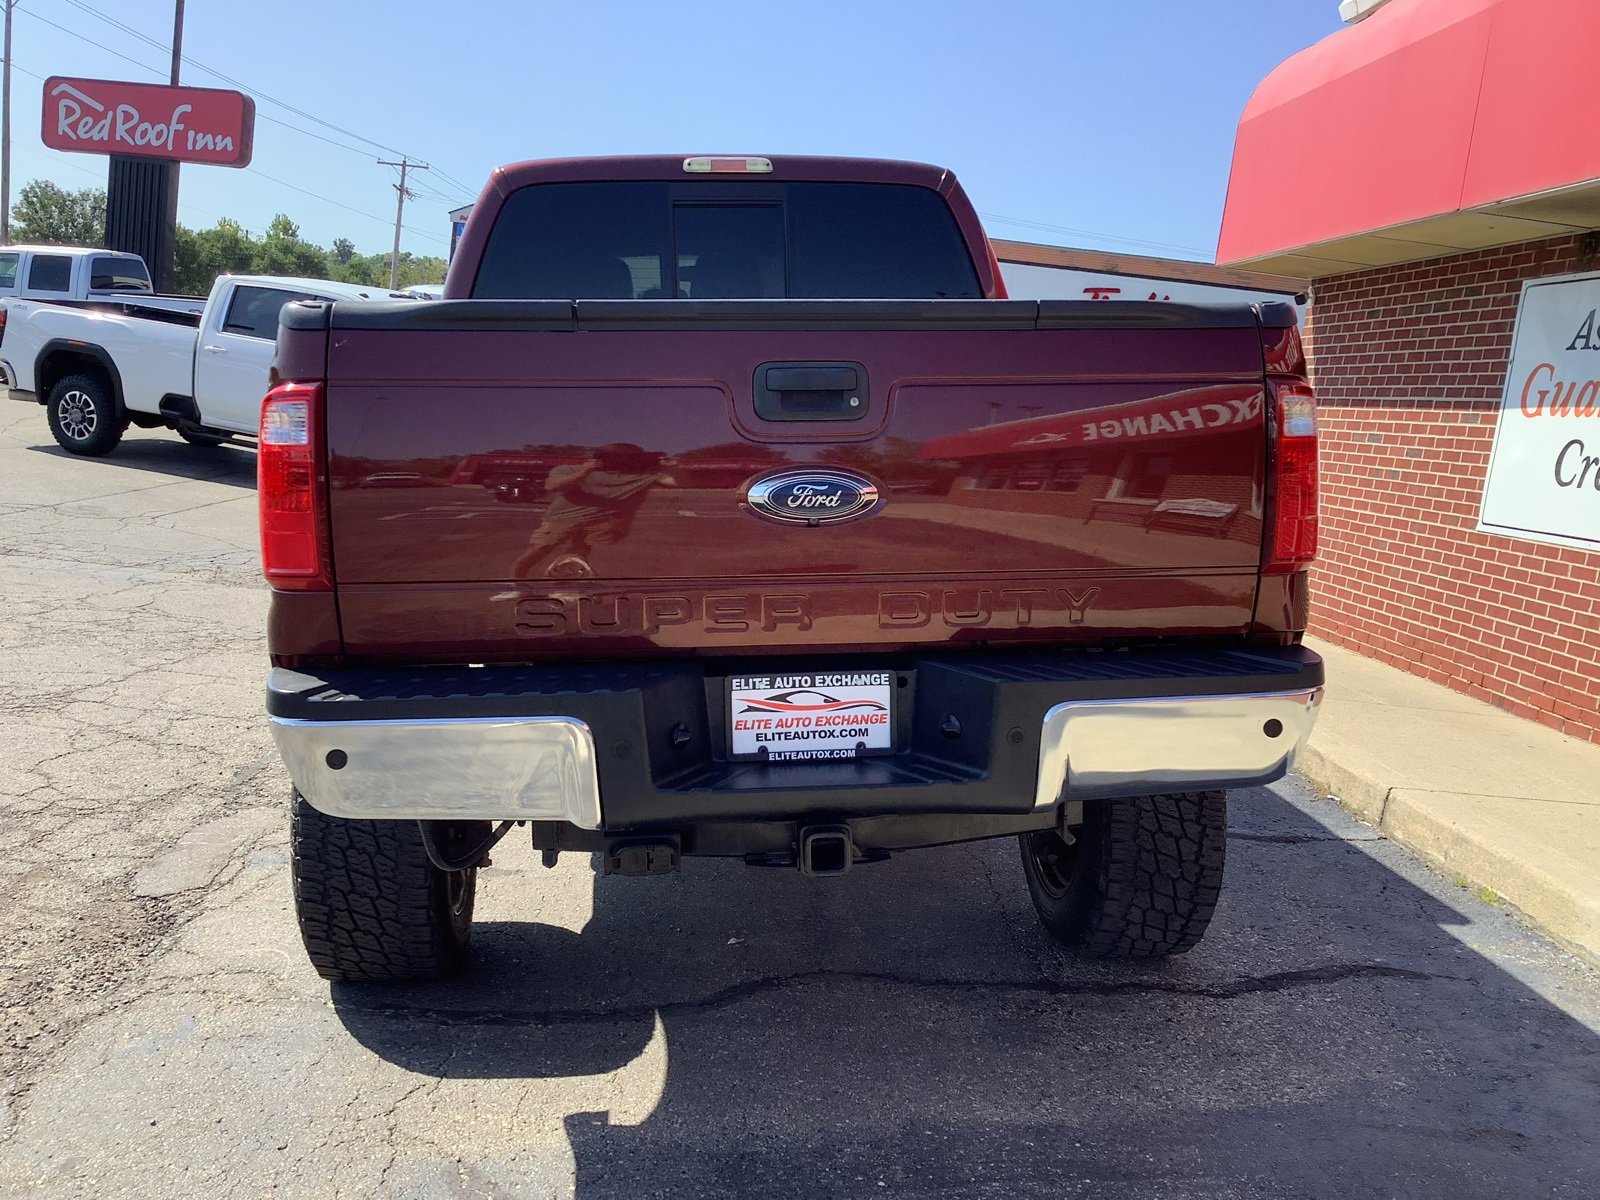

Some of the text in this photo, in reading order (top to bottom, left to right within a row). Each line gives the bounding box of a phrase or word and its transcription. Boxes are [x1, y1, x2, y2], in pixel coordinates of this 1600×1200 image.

[58, 99, 114, 141] Red
[115, 103, 192, 151] Roof
[1520, 363, 1600, 418] Gua
[787, 484, 842, 508] Ford
[514, 587, 1100, 635] SUPER DUTY
[732, 673, 890, 690] ELITE AUTO EXCHANGE
[734, 714, 888, 730] ELITE AUTO EXCHANGE
[755, 728, 869, 742] ELITEAUTOX.COM
[768, 749, 856, 761] ELITEAUTOX.COM
